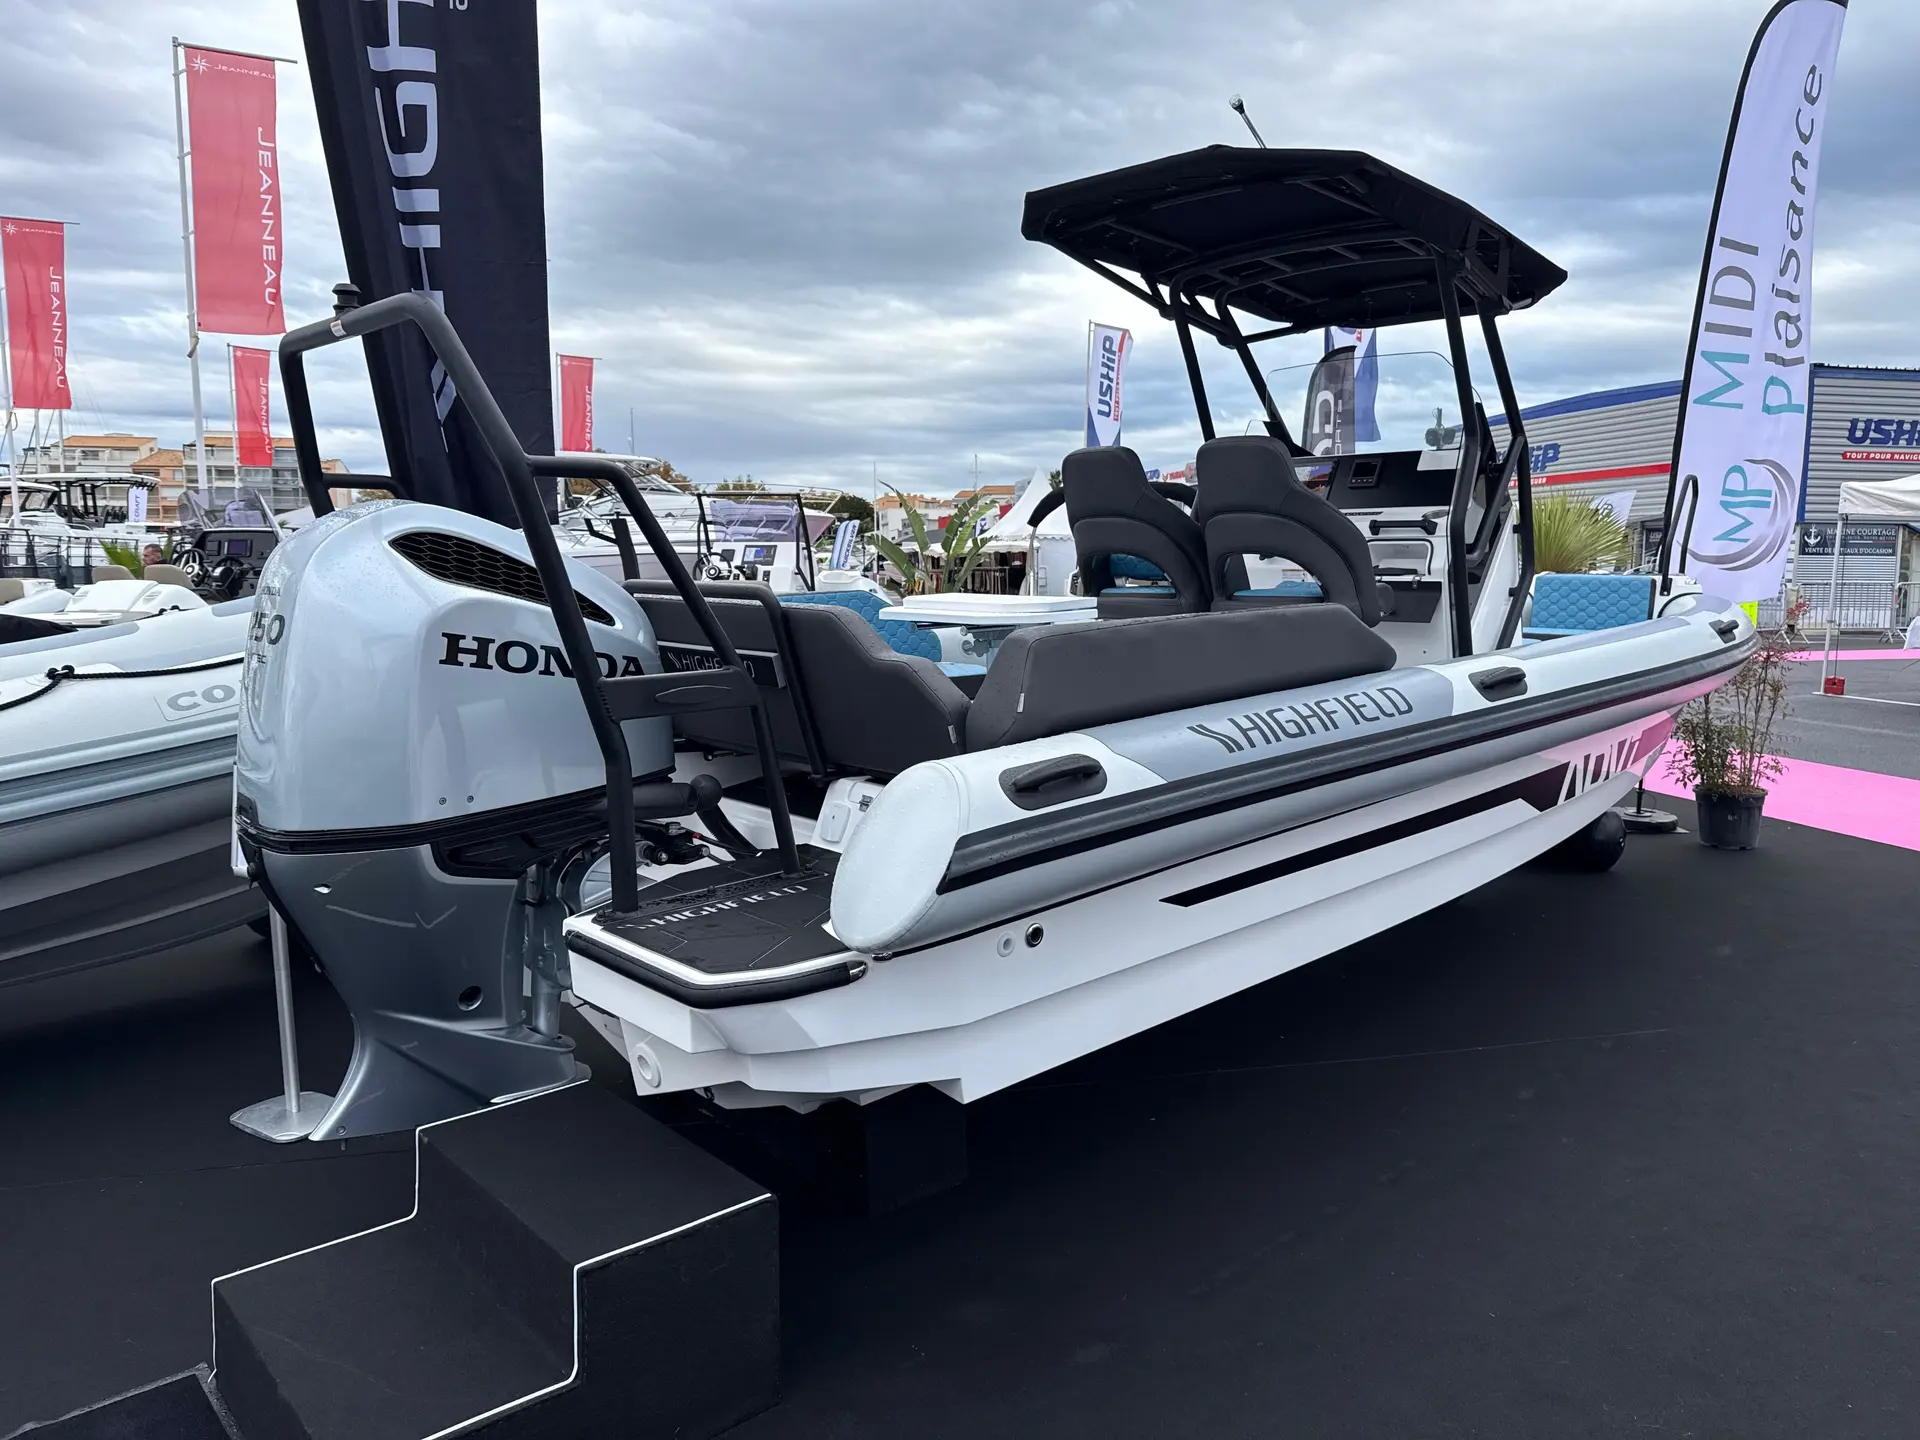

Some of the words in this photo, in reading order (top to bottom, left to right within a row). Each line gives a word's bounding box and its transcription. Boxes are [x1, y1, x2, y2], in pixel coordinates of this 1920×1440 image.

[214, 64, 275, 80] JEANNEAU
[20, 227, 64, 236] JEANNEAU
[257, 126, 277, 306] JEANNEAU
[1761, 64, 1822, 415] Plaisance
[49, 266, 65, 388] JEANNEAU
[1692, 236, 1759, 410] MIDI
[259, 377, 272, 454] JEANNEAU
[1847, 417, 1920, 445] USH
[1846, 452, 1868, 460] TOUT
[1713, 465, 1773, 543] MP
[1827, 527, 1856, 536] MAINE
[1856, 527, 1897, 536] COURTAGE
[1804, 546, 1824, 554] VENTE
[1824, 546, 1832, 554] DE
[1859, 547, 1893, 555] D'OCCASION
[1226, 686, 1414, 749] HIGHFIELD
